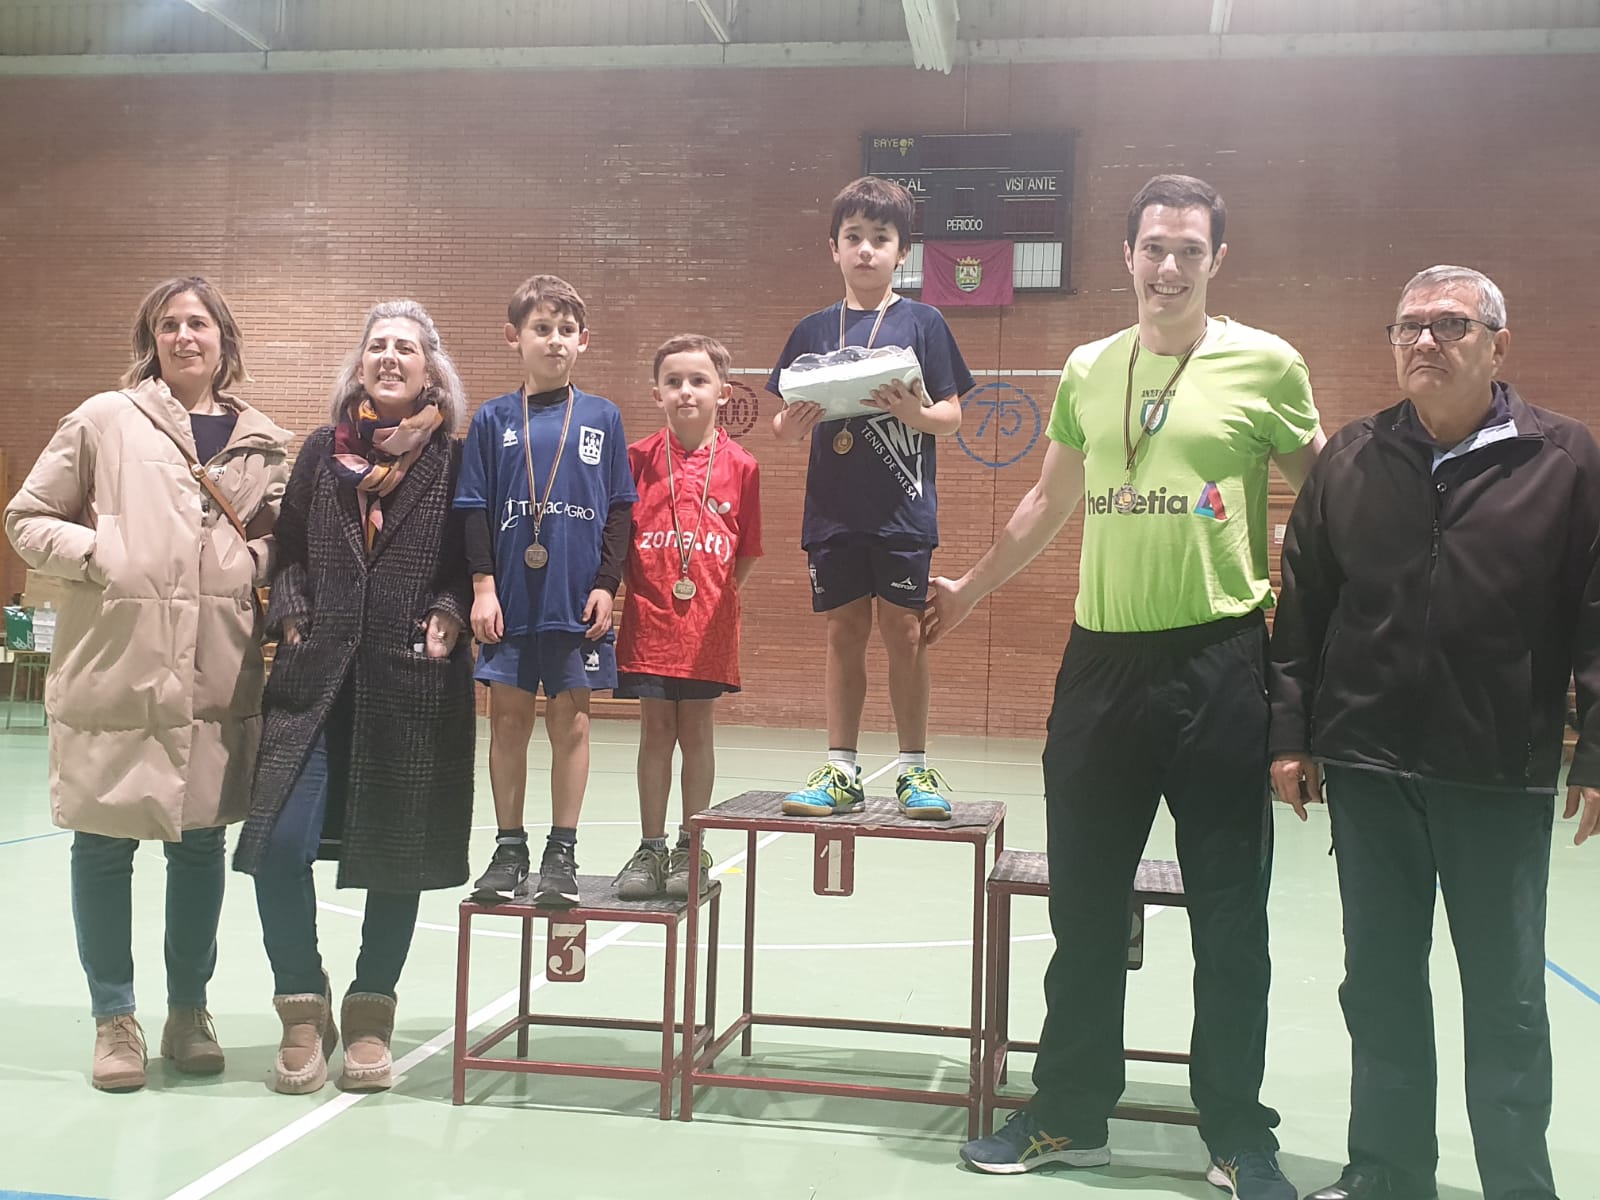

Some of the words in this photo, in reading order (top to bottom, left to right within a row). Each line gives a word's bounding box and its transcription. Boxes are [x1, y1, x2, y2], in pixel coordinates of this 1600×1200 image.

[1005, 177, 1057, 191] VISITANTE
[946, 219, 983, 231] PERIODO
[976, 401, 1022, 437] 75
[861, 425, 886, 455] TENIS
[883, 454, 897, 471] DE
[895, 471, 918, 501] MESA
[564, 503, 595, 521] AGRO
[1087, 487, 1188, 515] heletia
[820, 839, 845, 893] 1
[548, 923, 586, 976] 3
